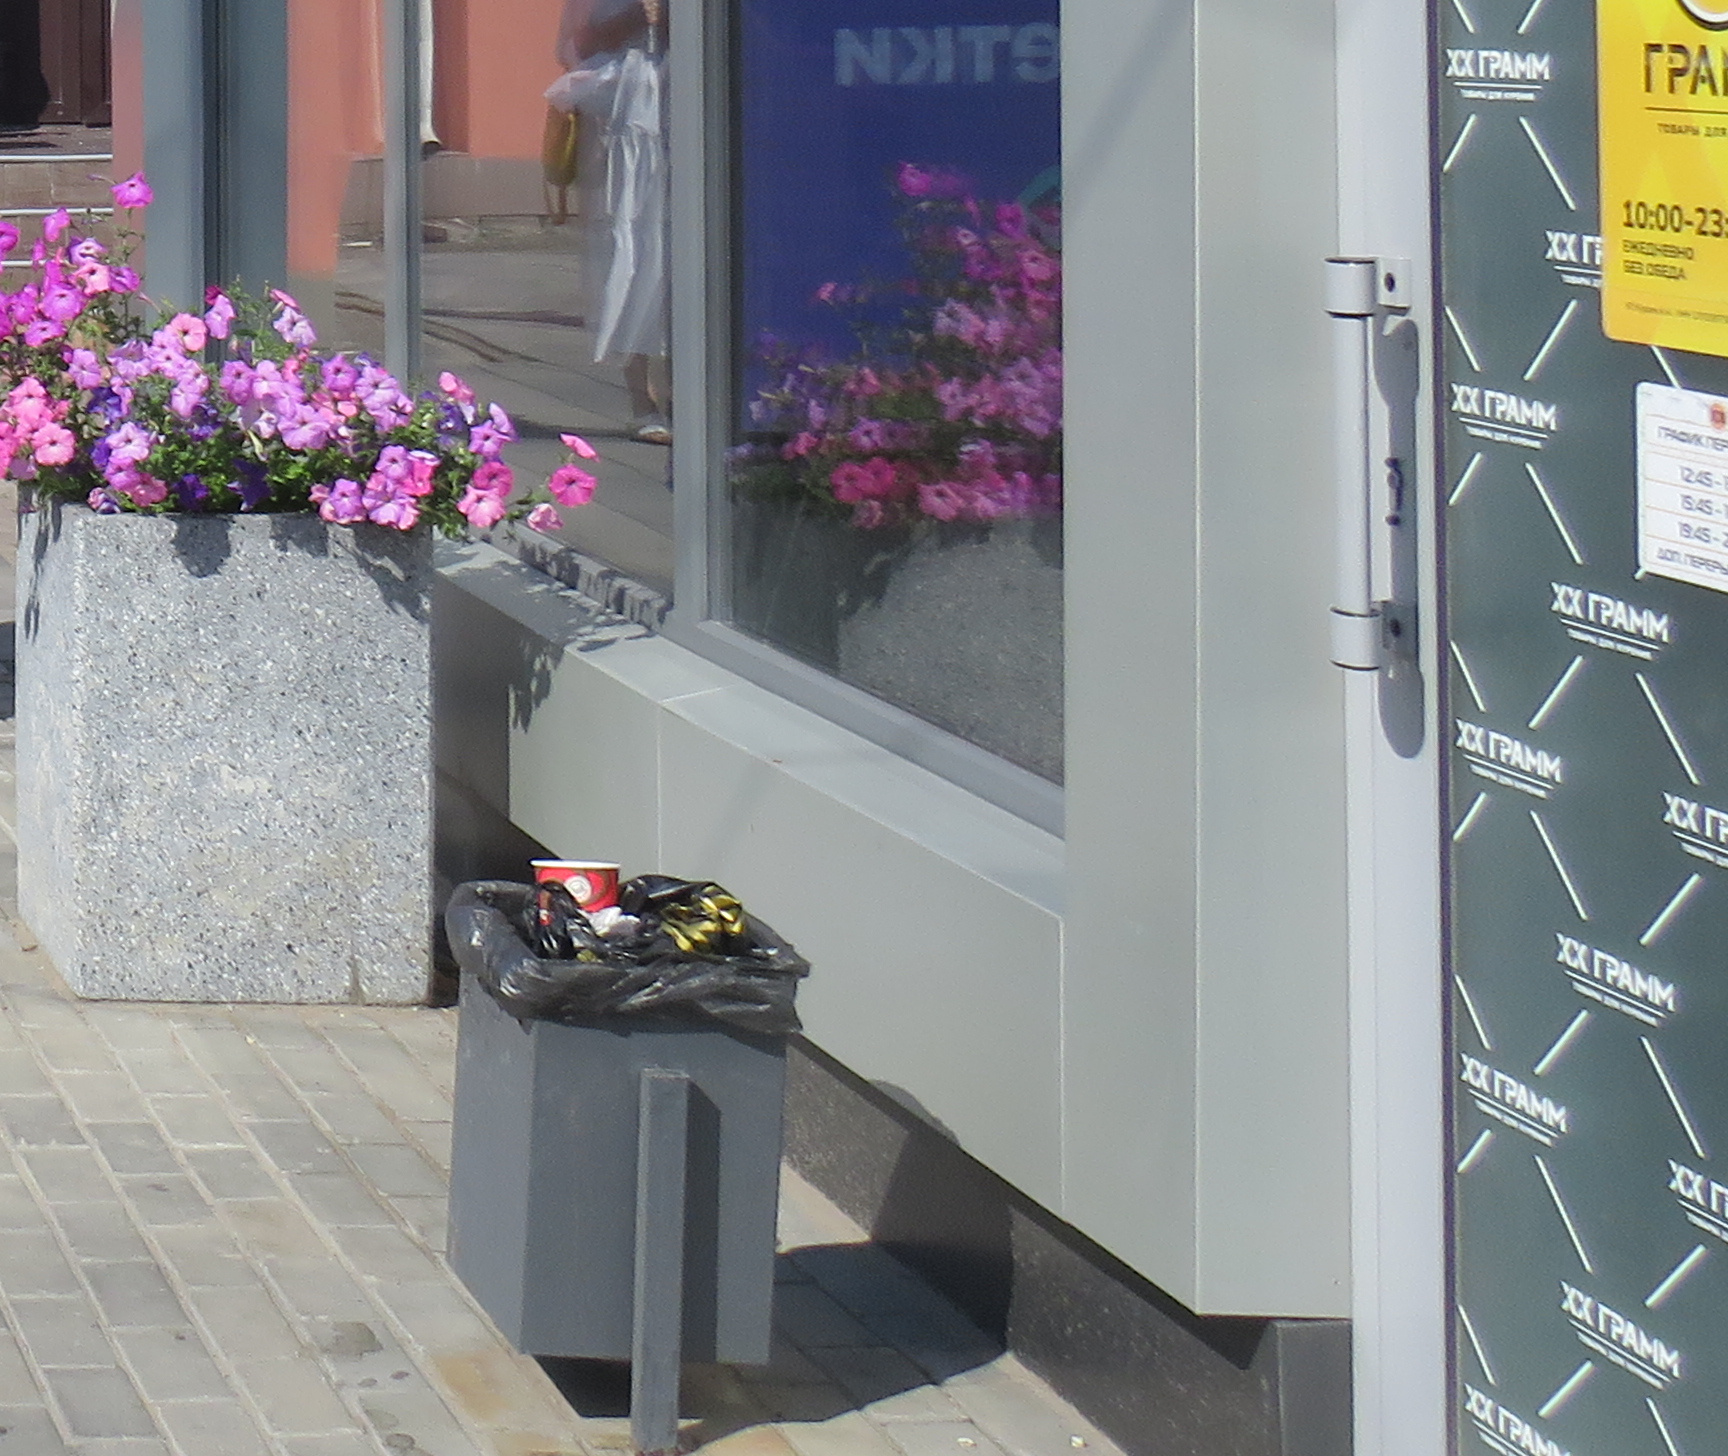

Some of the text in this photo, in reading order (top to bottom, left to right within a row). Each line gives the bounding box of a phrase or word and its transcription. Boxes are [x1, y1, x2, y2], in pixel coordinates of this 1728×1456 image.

[1478, 49, 1550, 81] ГРАММ
[1643, 42, 1728, 97] ГРА
[1622, 239, 1694, 260] ЕЖЕДНЕВНО
[1623, 260, 1687, 280] БЕЗ ОБЕДА
[1484, 389, 1558, 432] ГРАММ
[1588, 590, 1672, 644] ГРАММ
[1489, 730, 1562, 783] ГРАММ
[1592, 951, 1676, 1013] ГРАММ
[1492, 1068, 1569, 1133] ГРАММ
[1597, 1297, 1682, 1379] ГРАММ
